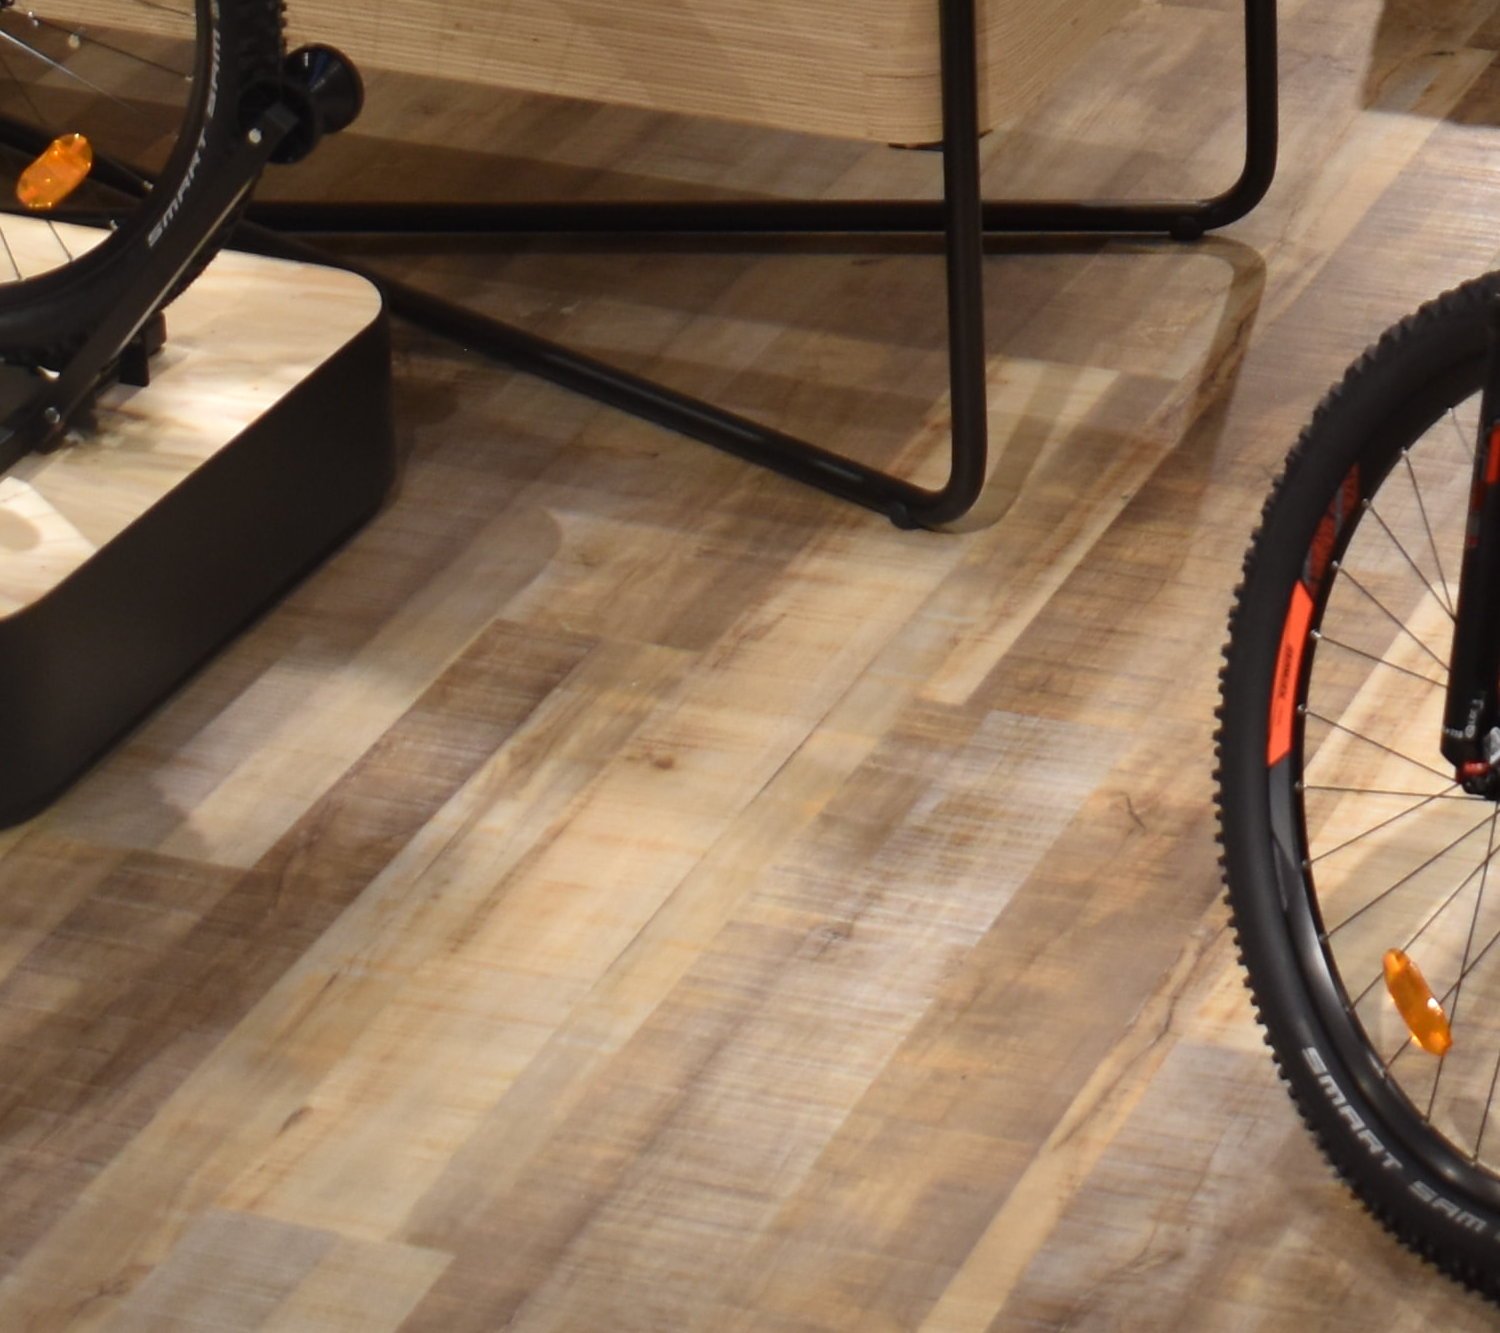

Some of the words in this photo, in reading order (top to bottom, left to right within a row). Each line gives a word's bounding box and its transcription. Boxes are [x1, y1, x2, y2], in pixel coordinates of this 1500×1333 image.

[148, 130, 208, 247] SMART
[1301, 1046, 1402, 1171] SMART
[1407, 1181, 1488, 1233] SAM
